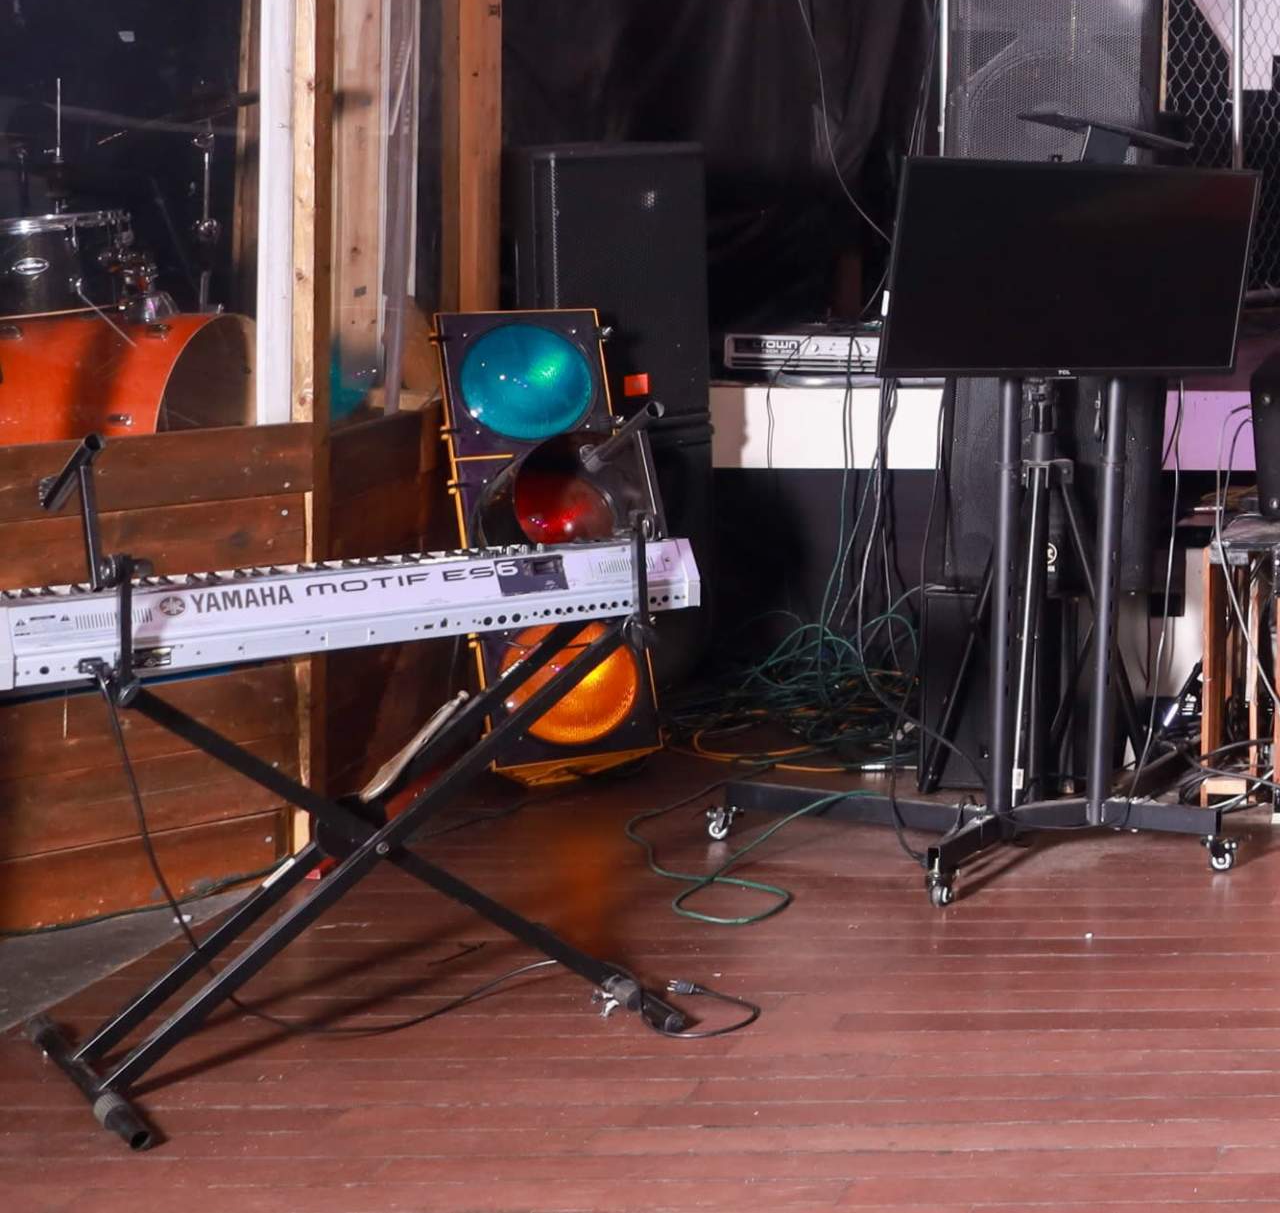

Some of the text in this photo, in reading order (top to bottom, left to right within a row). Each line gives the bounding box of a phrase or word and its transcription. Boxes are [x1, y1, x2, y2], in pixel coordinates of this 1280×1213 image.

[189, 560, 519, 614] YAMAHA MOTIF ES6
